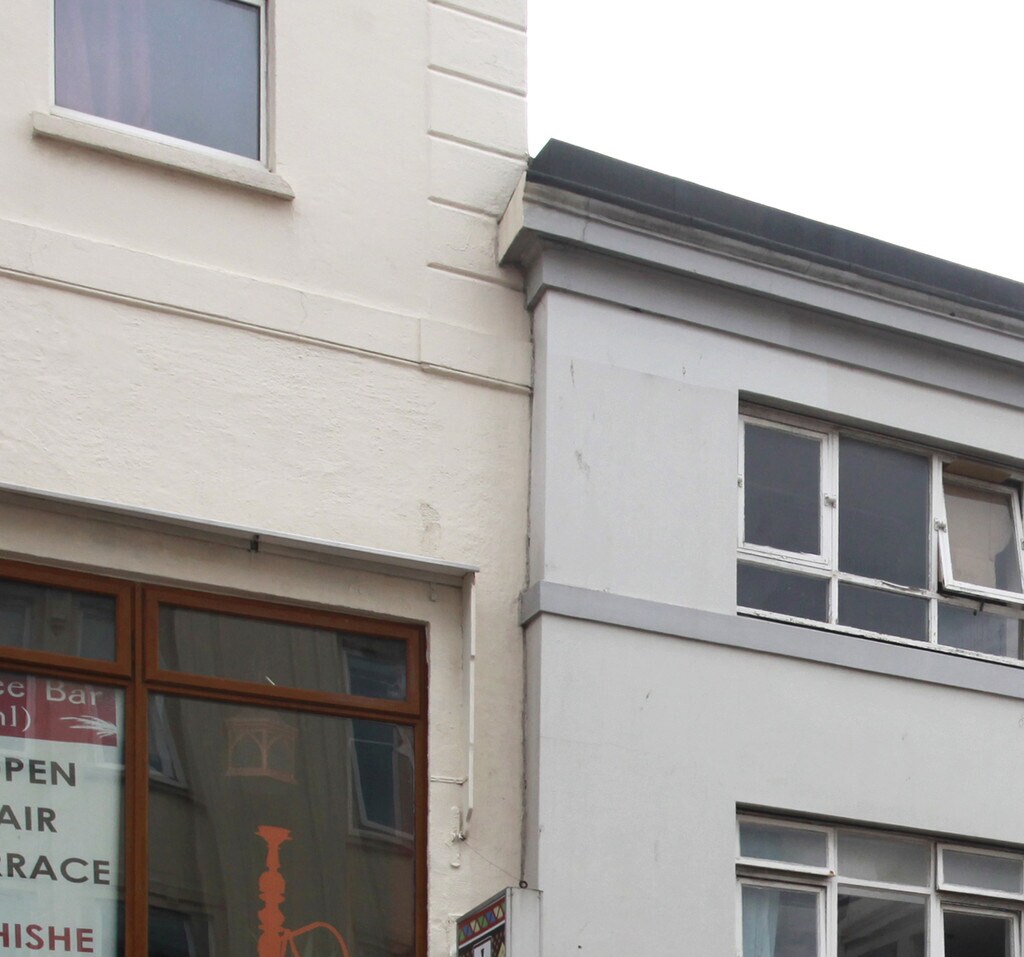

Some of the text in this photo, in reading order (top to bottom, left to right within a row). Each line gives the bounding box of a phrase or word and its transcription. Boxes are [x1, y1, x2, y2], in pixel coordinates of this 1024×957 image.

[46, 680, 103, 706] Bar
[0, 757, 76, 787] PEN
[0, 804, 58, 833] AIR
[0, 852, 110, 886] RACE
